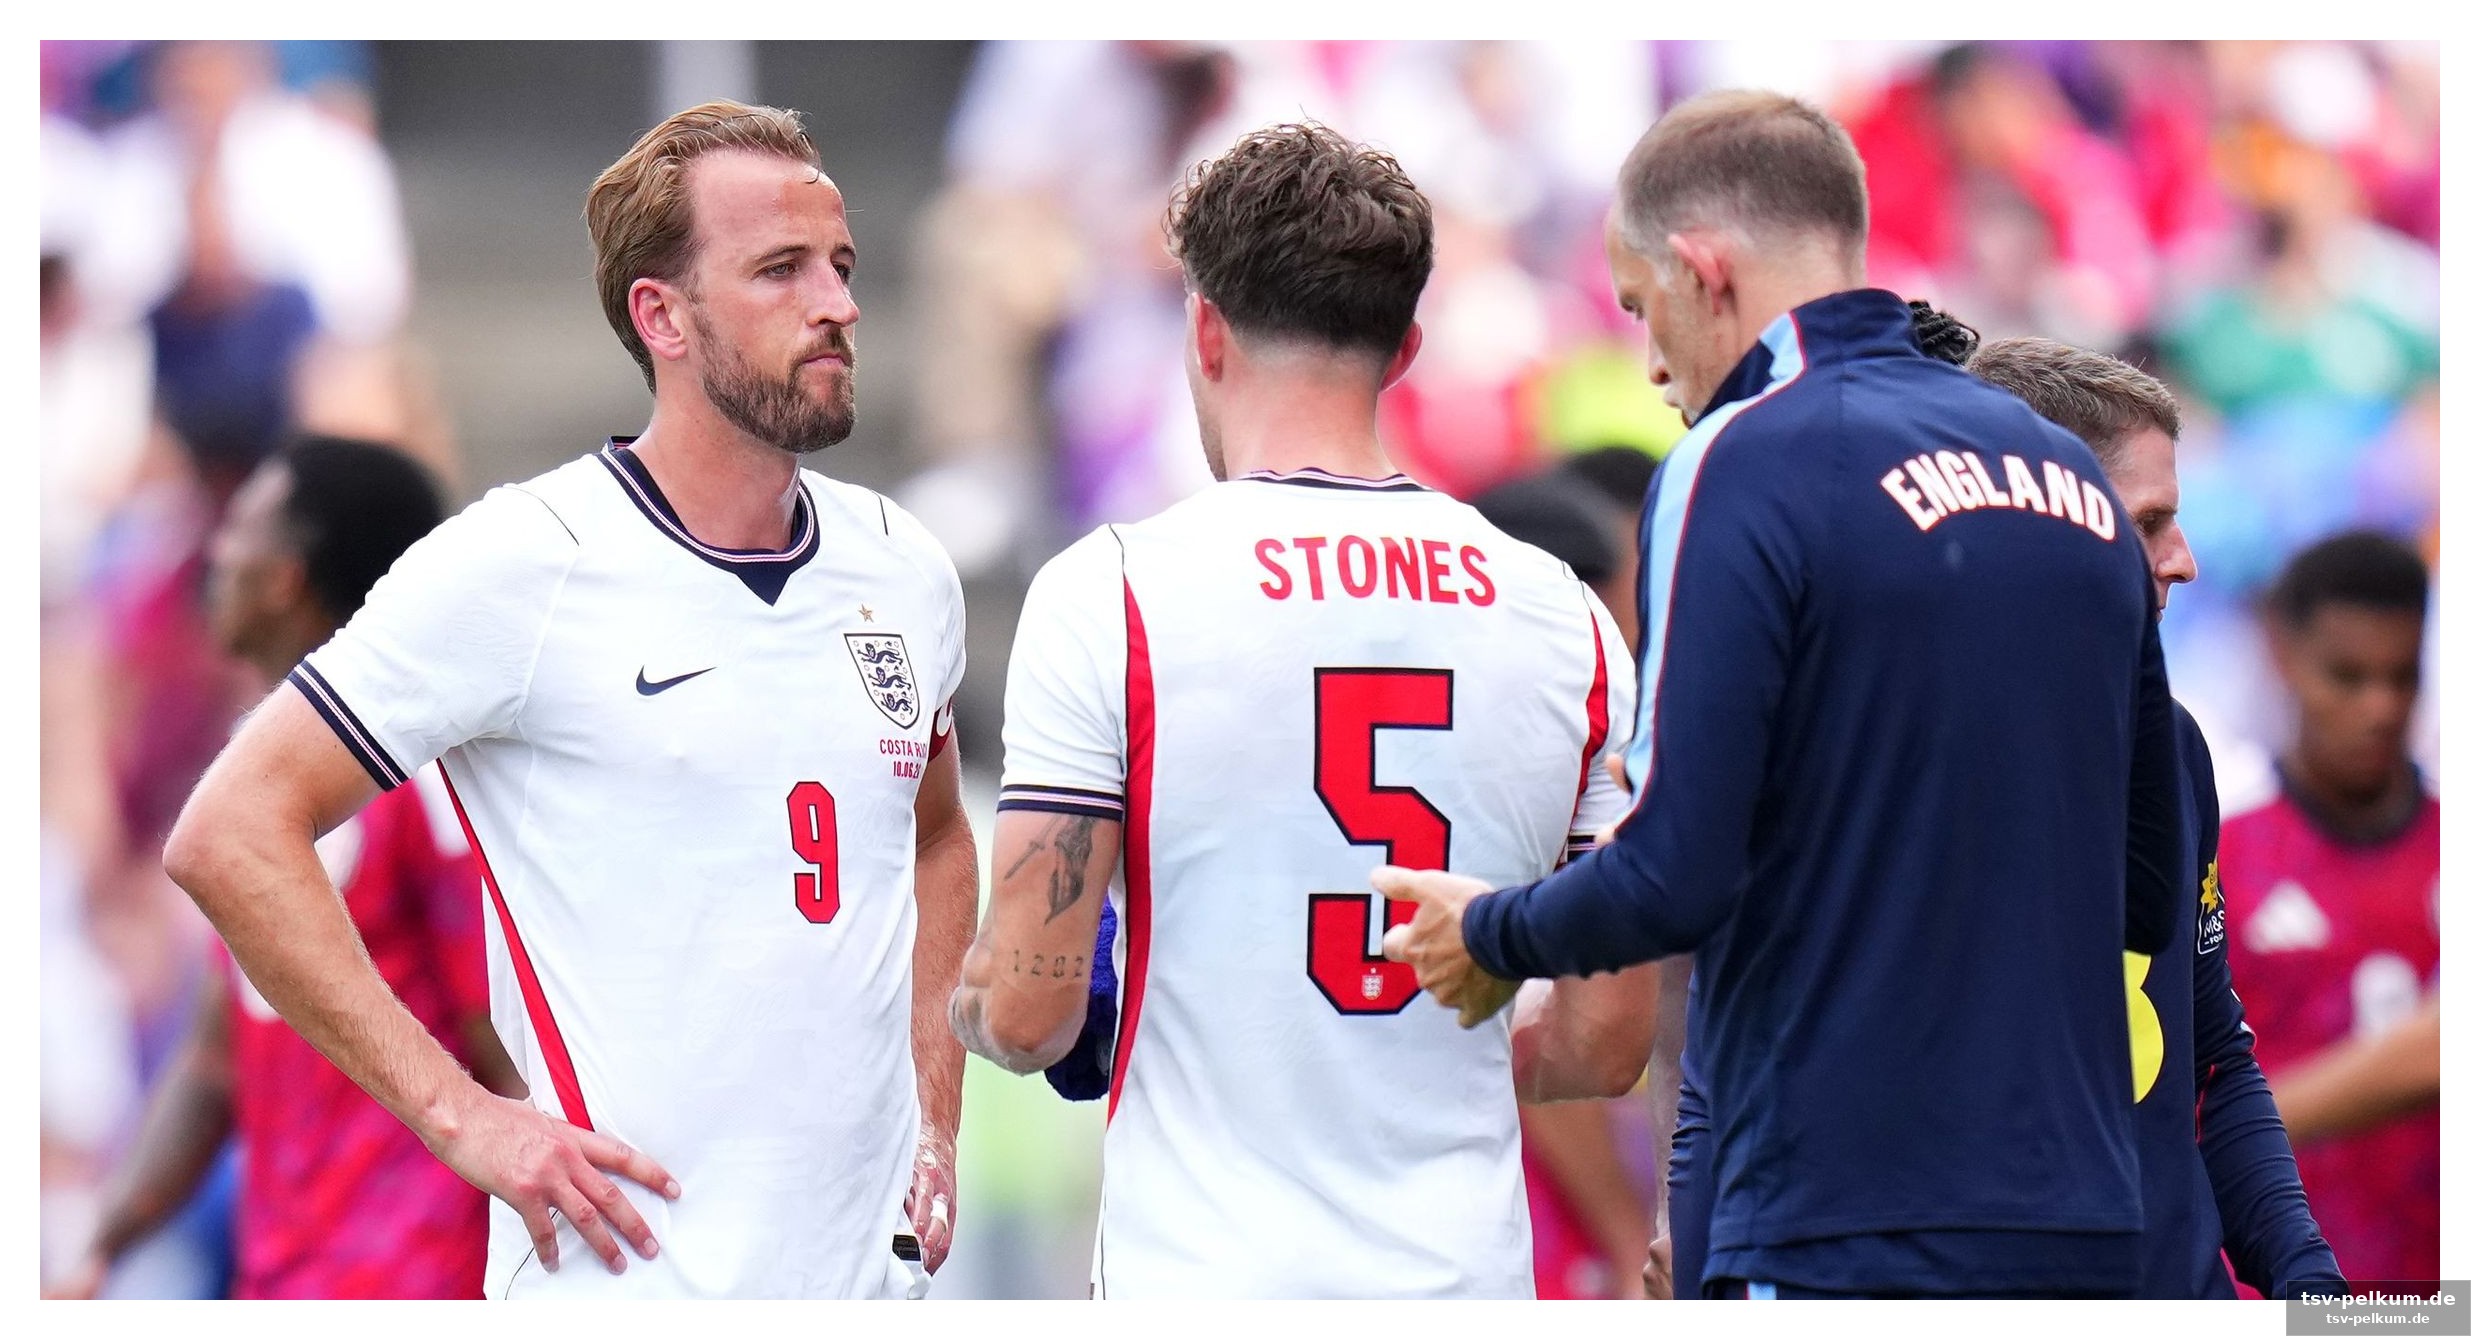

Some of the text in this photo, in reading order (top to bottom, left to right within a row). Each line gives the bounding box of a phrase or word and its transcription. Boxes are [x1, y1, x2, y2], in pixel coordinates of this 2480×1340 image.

[1879, 449, 2118, 543] ENGLAND
[1254, 534, 1497, 607] STONES
[879, 739, 914, 757] COSTA
[786, 781, 841, 924] 9
[1306, 667, 1454, 1016] 5
